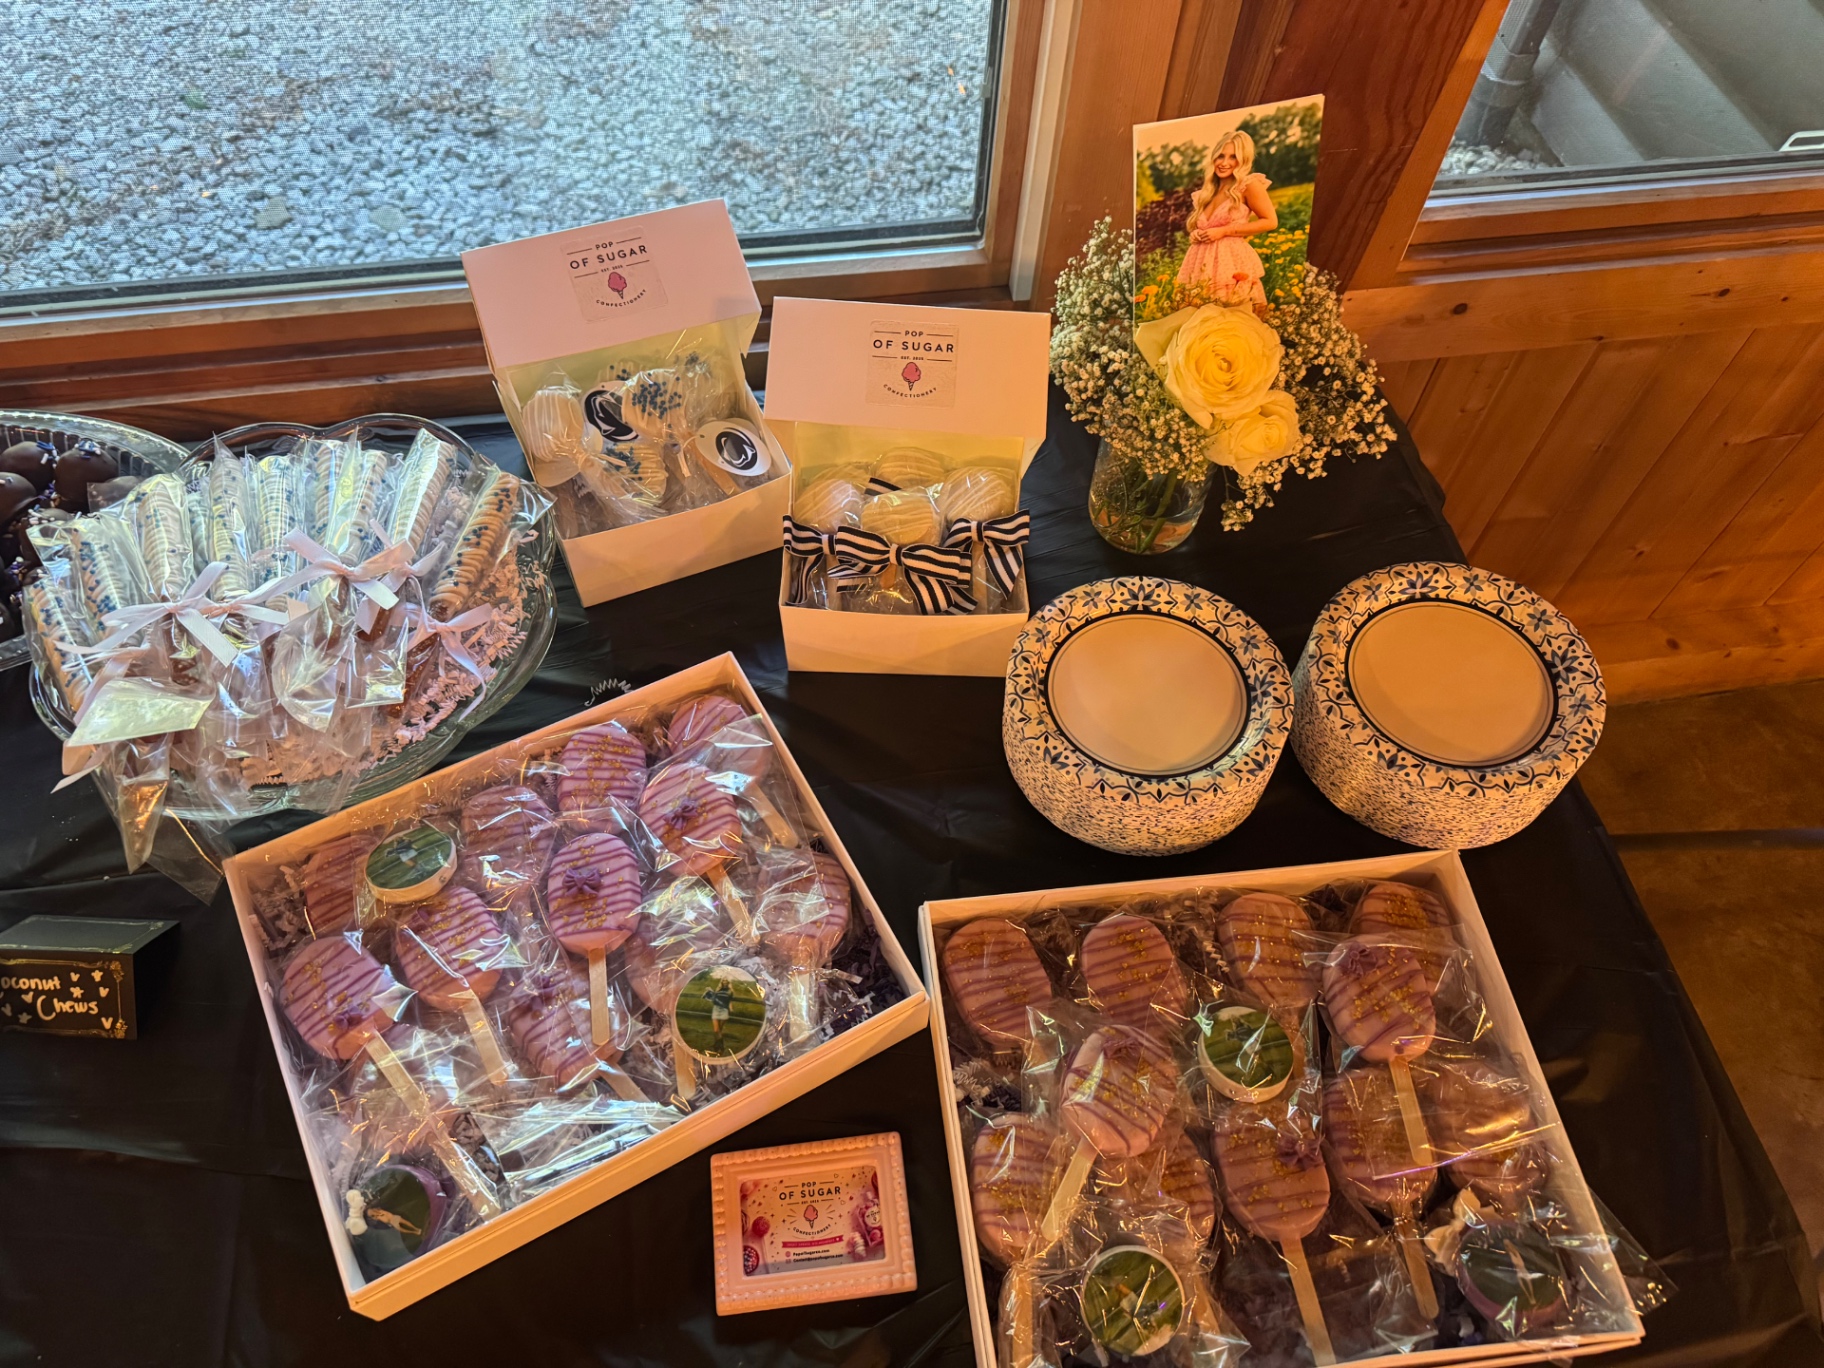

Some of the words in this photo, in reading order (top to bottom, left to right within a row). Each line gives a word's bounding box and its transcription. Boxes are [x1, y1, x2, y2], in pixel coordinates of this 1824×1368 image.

[595, 241, 614, 250] POP
[569, 257, 589, 270] OF
[596, 244, 648, 264] SUGAR
[595, 288, 647, 308] CONFECTIONERY
[873, 339, 893, 349] OF
[901, 341, 954, 353] SUGAR
[883, 383, 937, 398] CONFECTIONERY
[0, 975, 61, 991] oconut
[36, 995, 99, 1022] Chews
[779, 1191, 795, 1201] OF
[800, 1186, 841, 1199] SUGAR
[792, 1223, 832, 1236] CONFECTIONERY
